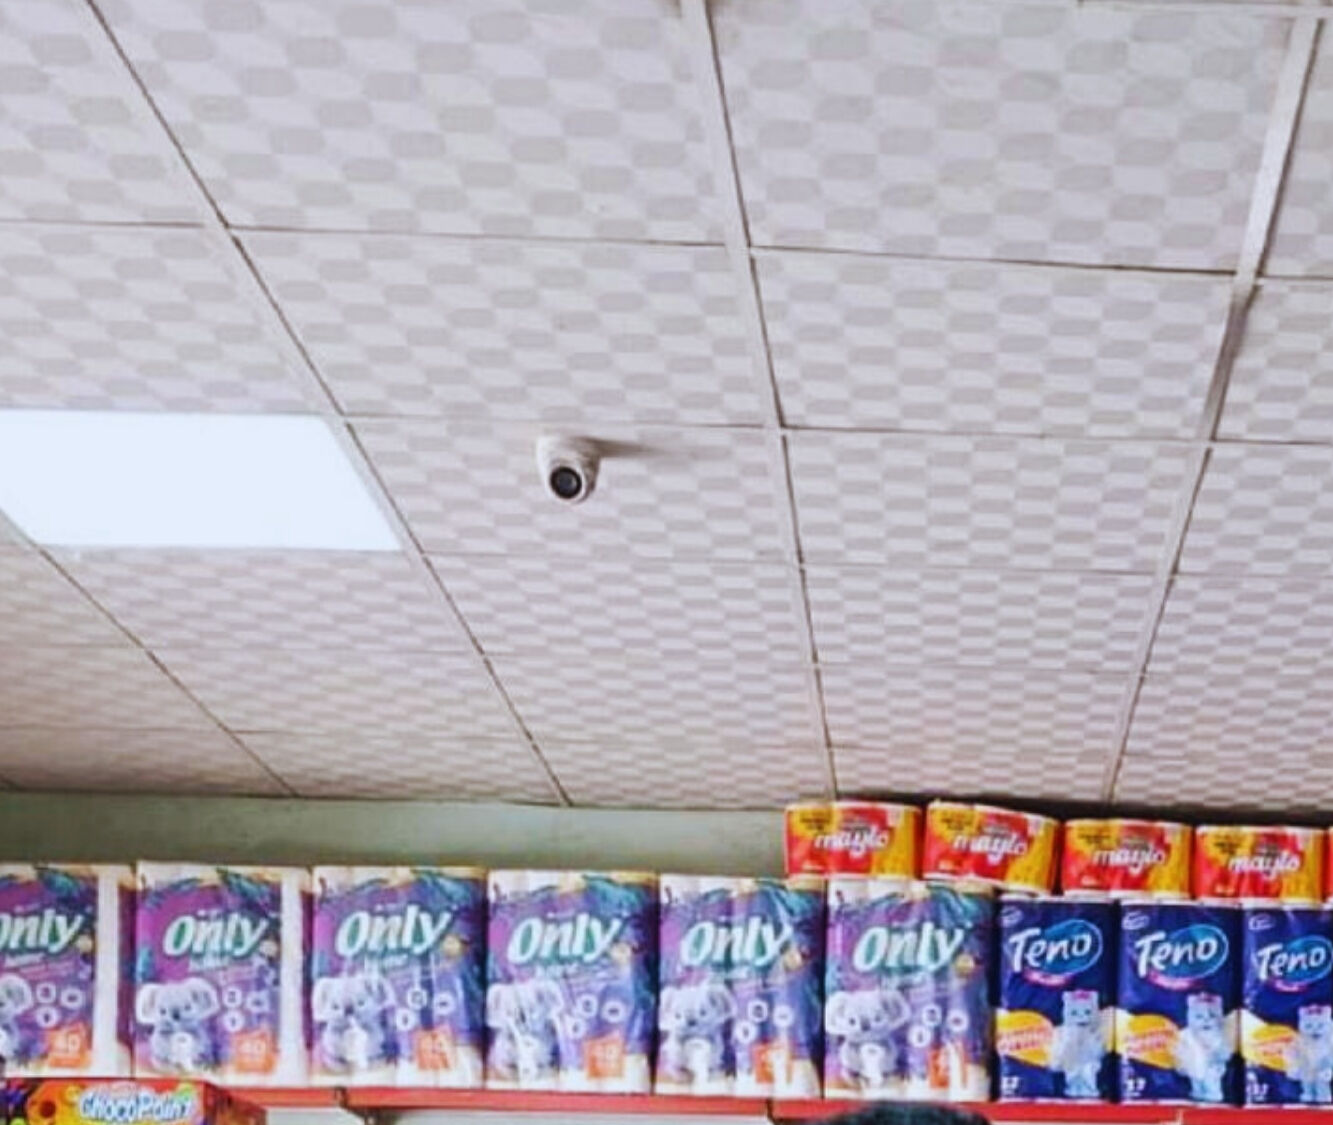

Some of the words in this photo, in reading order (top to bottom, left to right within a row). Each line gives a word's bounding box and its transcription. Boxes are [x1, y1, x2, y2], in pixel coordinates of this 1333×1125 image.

[815, 828, 888, 858] maylo
[953, 830, 1028, 866] maylo
[1092, 842, 1167, 875] maylo
[1228, 851, 1300, 883] maylo
[163, 909, 269, 957] Only
[336, 905, 451, 956] Only
[507, 912, 622, 964] Only
[680, 916, 793, 967] Only
[853, 922, 964, 973] Only
[1008, 927, 1092, 973] Teno
[1135, 931, 1218, 977] Teno
[1257, 943, 1326, 980] Teno
